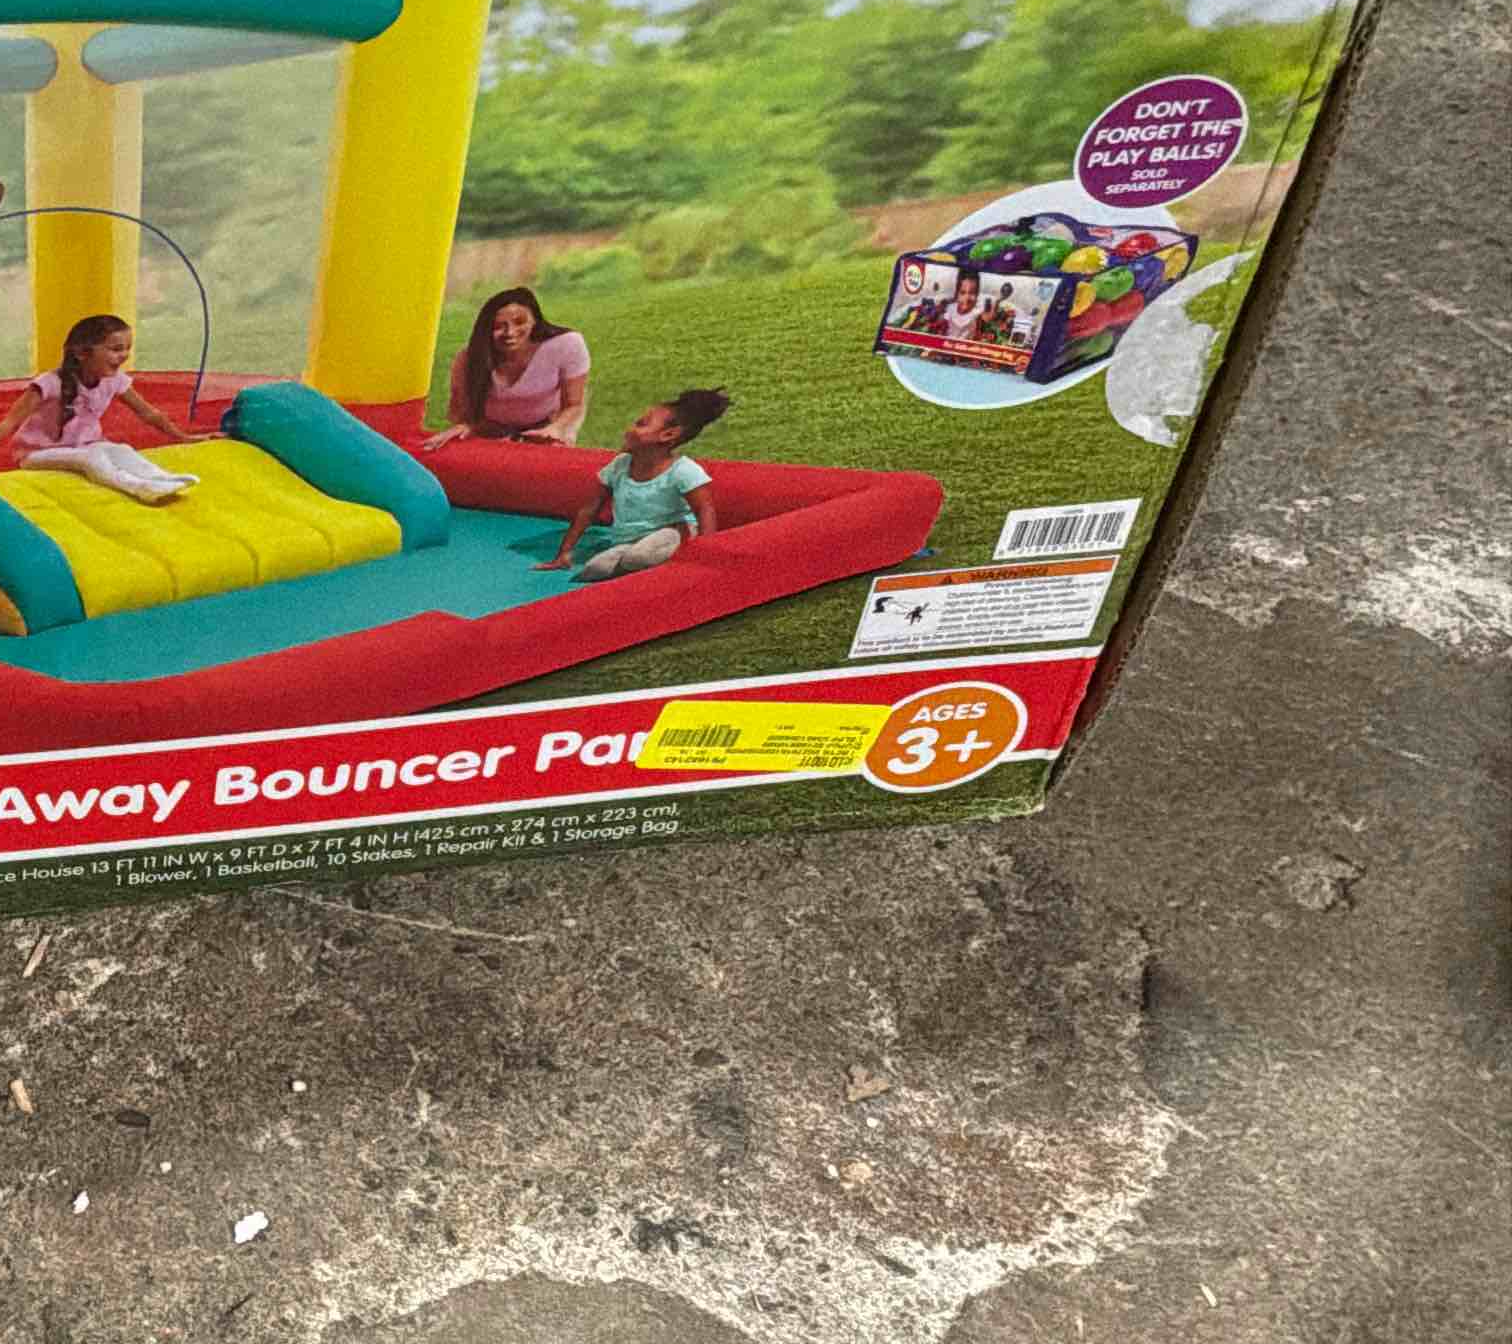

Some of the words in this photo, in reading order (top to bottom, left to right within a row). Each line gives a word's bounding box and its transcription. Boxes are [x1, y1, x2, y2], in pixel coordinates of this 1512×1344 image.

[1134, 97, 1212, 120] DON'T
[1094, 123, 1185, 146] FORGET
[1190, 117, 1233, 138] THE
[1087, 149, 1144, 169] PLAY
[1149, 142, 1227, 164] BALLS!
[1104, 178, 1187, 195] SEPARATELY
[1130, 167, 1168, 182] SOLD
[910, 702, 988, 723] AGES
[887, 727, 993, 775] 3+
[214, 742, 516, 806] Bouncer
[535, 730, 648, 773] Par
[22, 862, 84, 881] House
[91, 860, 109, 874] 13
[115, 858, 135, 871] FT
[143, 855, 156, 869] 11
[163, 853, 183, 867] IN
[187, 850, 208, 864] W
[212, 850, 223, 862] x
[228, 847, 241, 860] 9
[247, 844, 267, 859] FT
[271, 842, 286, 856] D
[290, 842, 303, 854] x
[307, 838, 319, 852] 7
[324, 836, 345, 851] FT
[349, 834, 361, 848] 4
[367, 831, 388, 847] IN
[392, 829, 408, 844] H
[458, 823, 490, 837] cm
[493, 821, 506, 834] x
[510, 815, 545, 832] 274
[551, 813, 580, 827] cm
[585, 812, 597, 824] x
[600, 805, 638, 823] 223
[115, 874, 121, 886] 1
[205, 865, 211, 877] 1
[326, 852, 347, 866] 10
[424, 842, 432, 855] 1
[436, 835, 499, 856] Repair
[501, 832, 526, 848] Kit
[530, 830, 546, 845] &
[563, 820, 637, 843] Storage
[640, 815, 680, 836] Bag
